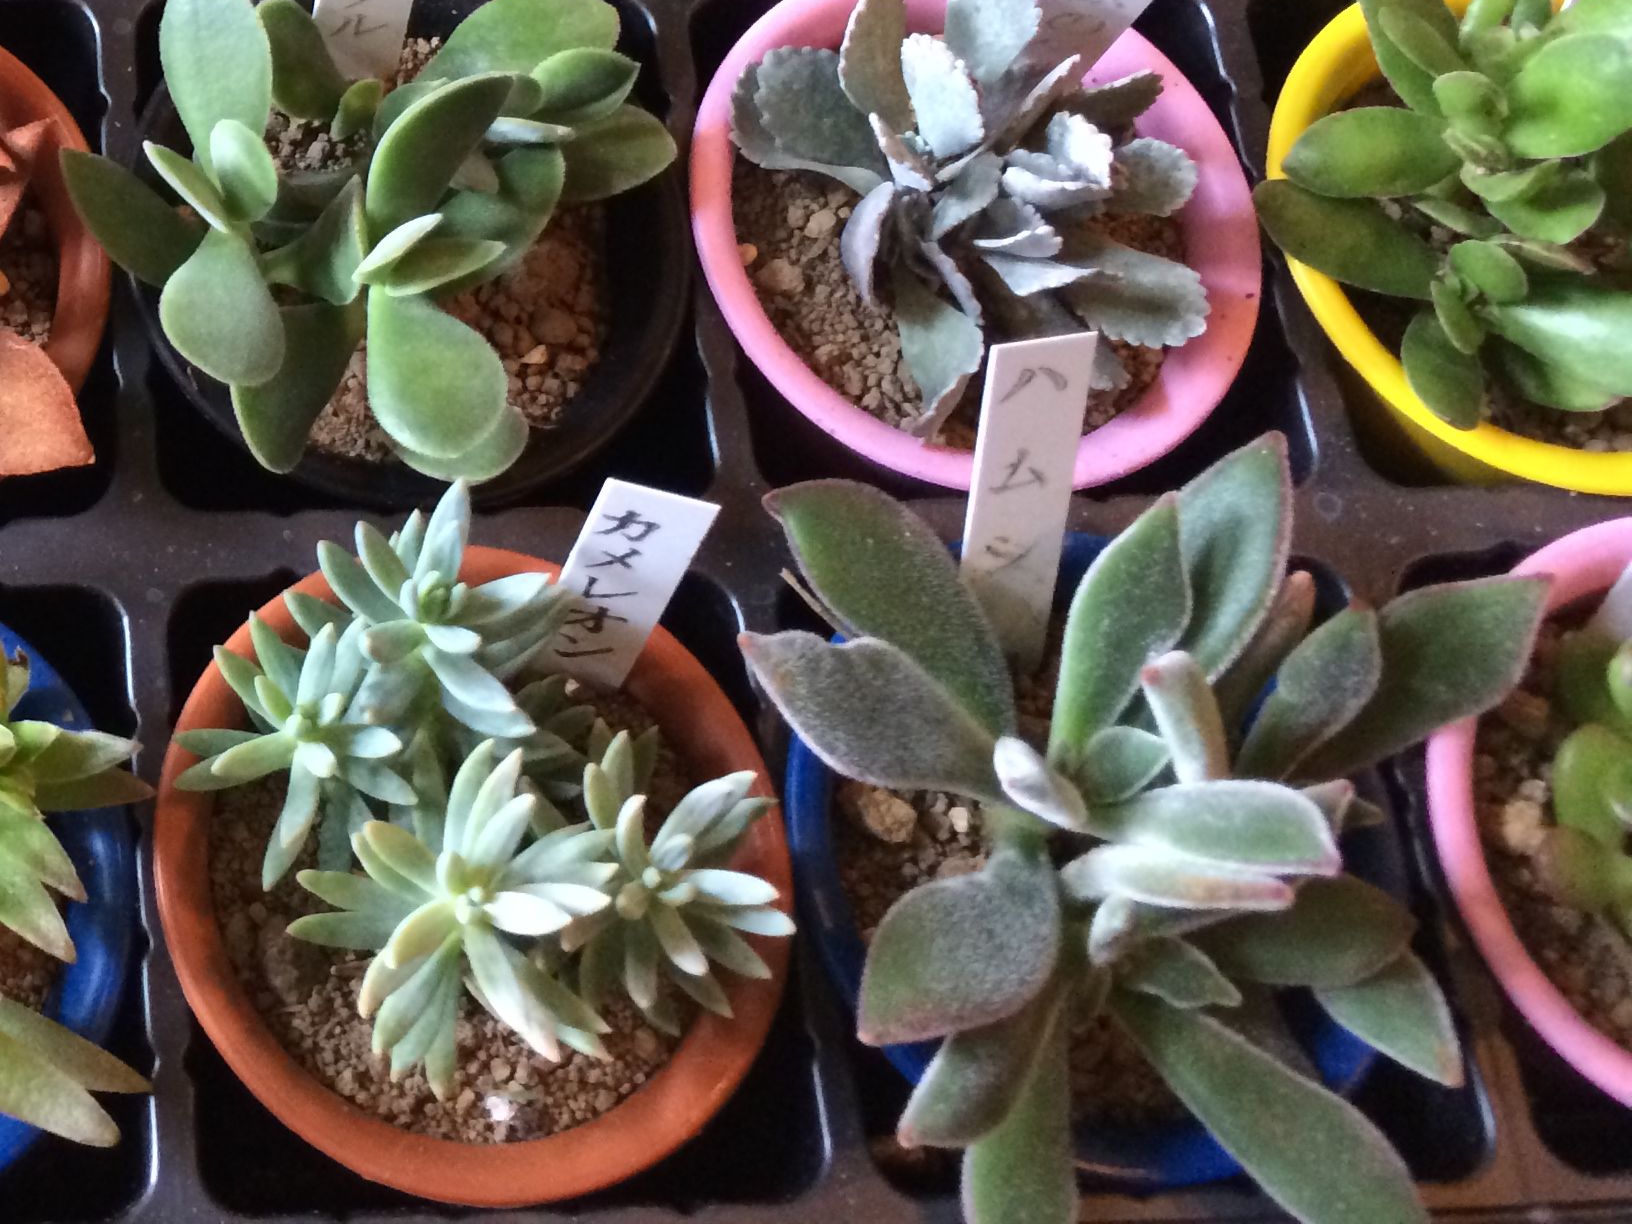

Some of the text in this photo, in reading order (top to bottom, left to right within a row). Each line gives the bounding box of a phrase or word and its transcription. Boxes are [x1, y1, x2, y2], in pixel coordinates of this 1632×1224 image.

[553, 509, 662, 658] カメレオン
